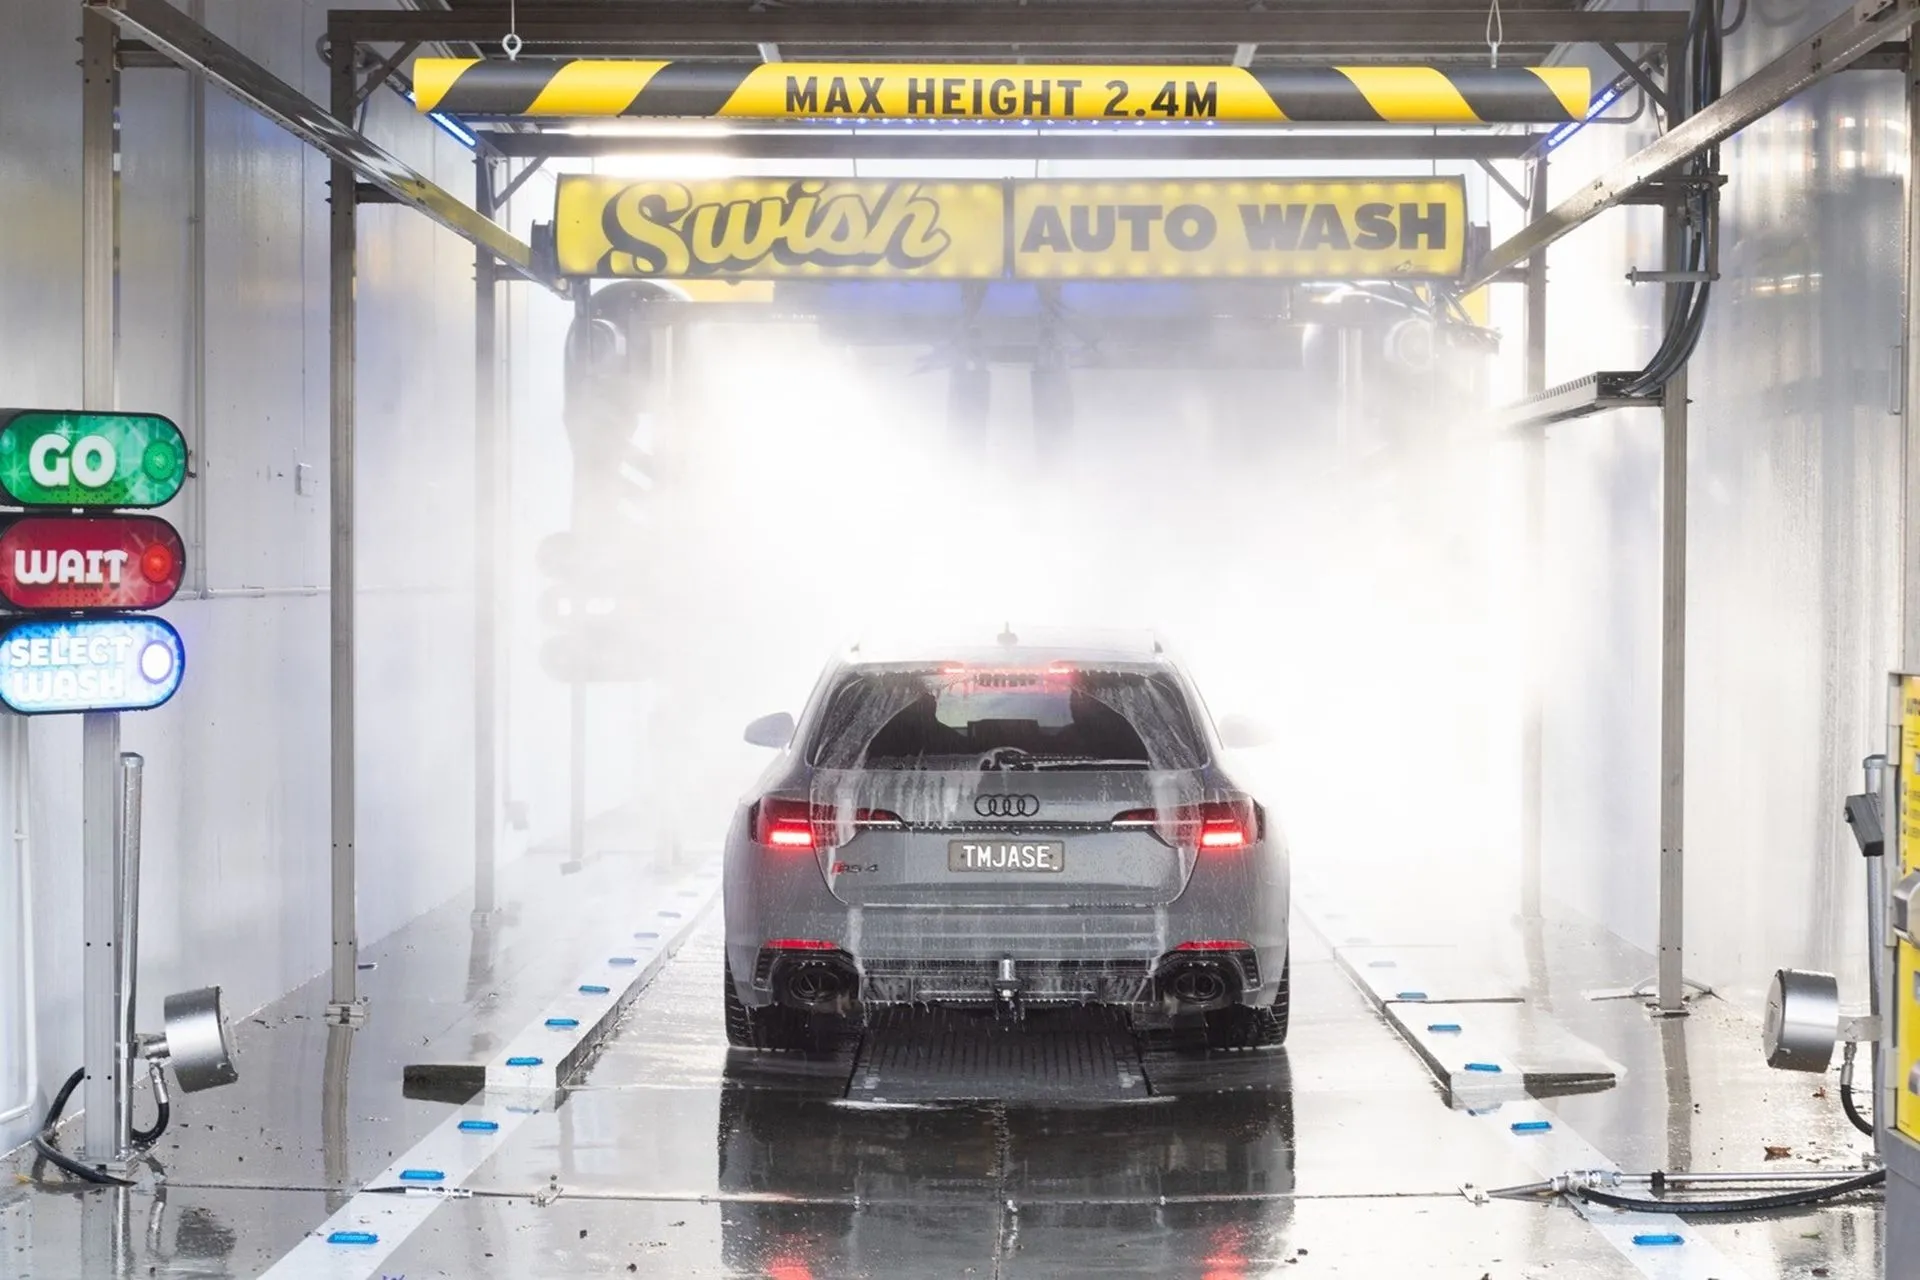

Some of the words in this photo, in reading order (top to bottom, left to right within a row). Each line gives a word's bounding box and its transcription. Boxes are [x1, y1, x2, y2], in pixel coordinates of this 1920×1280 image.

[786, 76, 885, 113] MAX
[908, 78, 1082, 117] HEIGHT
[1103, 80, 1217, 117] 2.4M
[599, 180, 951, 276] Swish
[1020, 205, 1217, 253] AUTO
[1238, 202, 1447, 252] WASH
[28, 433, 117, 488] GO
[14, 549, 129, 585] WAIT
[10, 636, 133, 667] SELECT
[13, 668, 126, 702] WASH
[962, 845, 1051, 868] TMJASE
